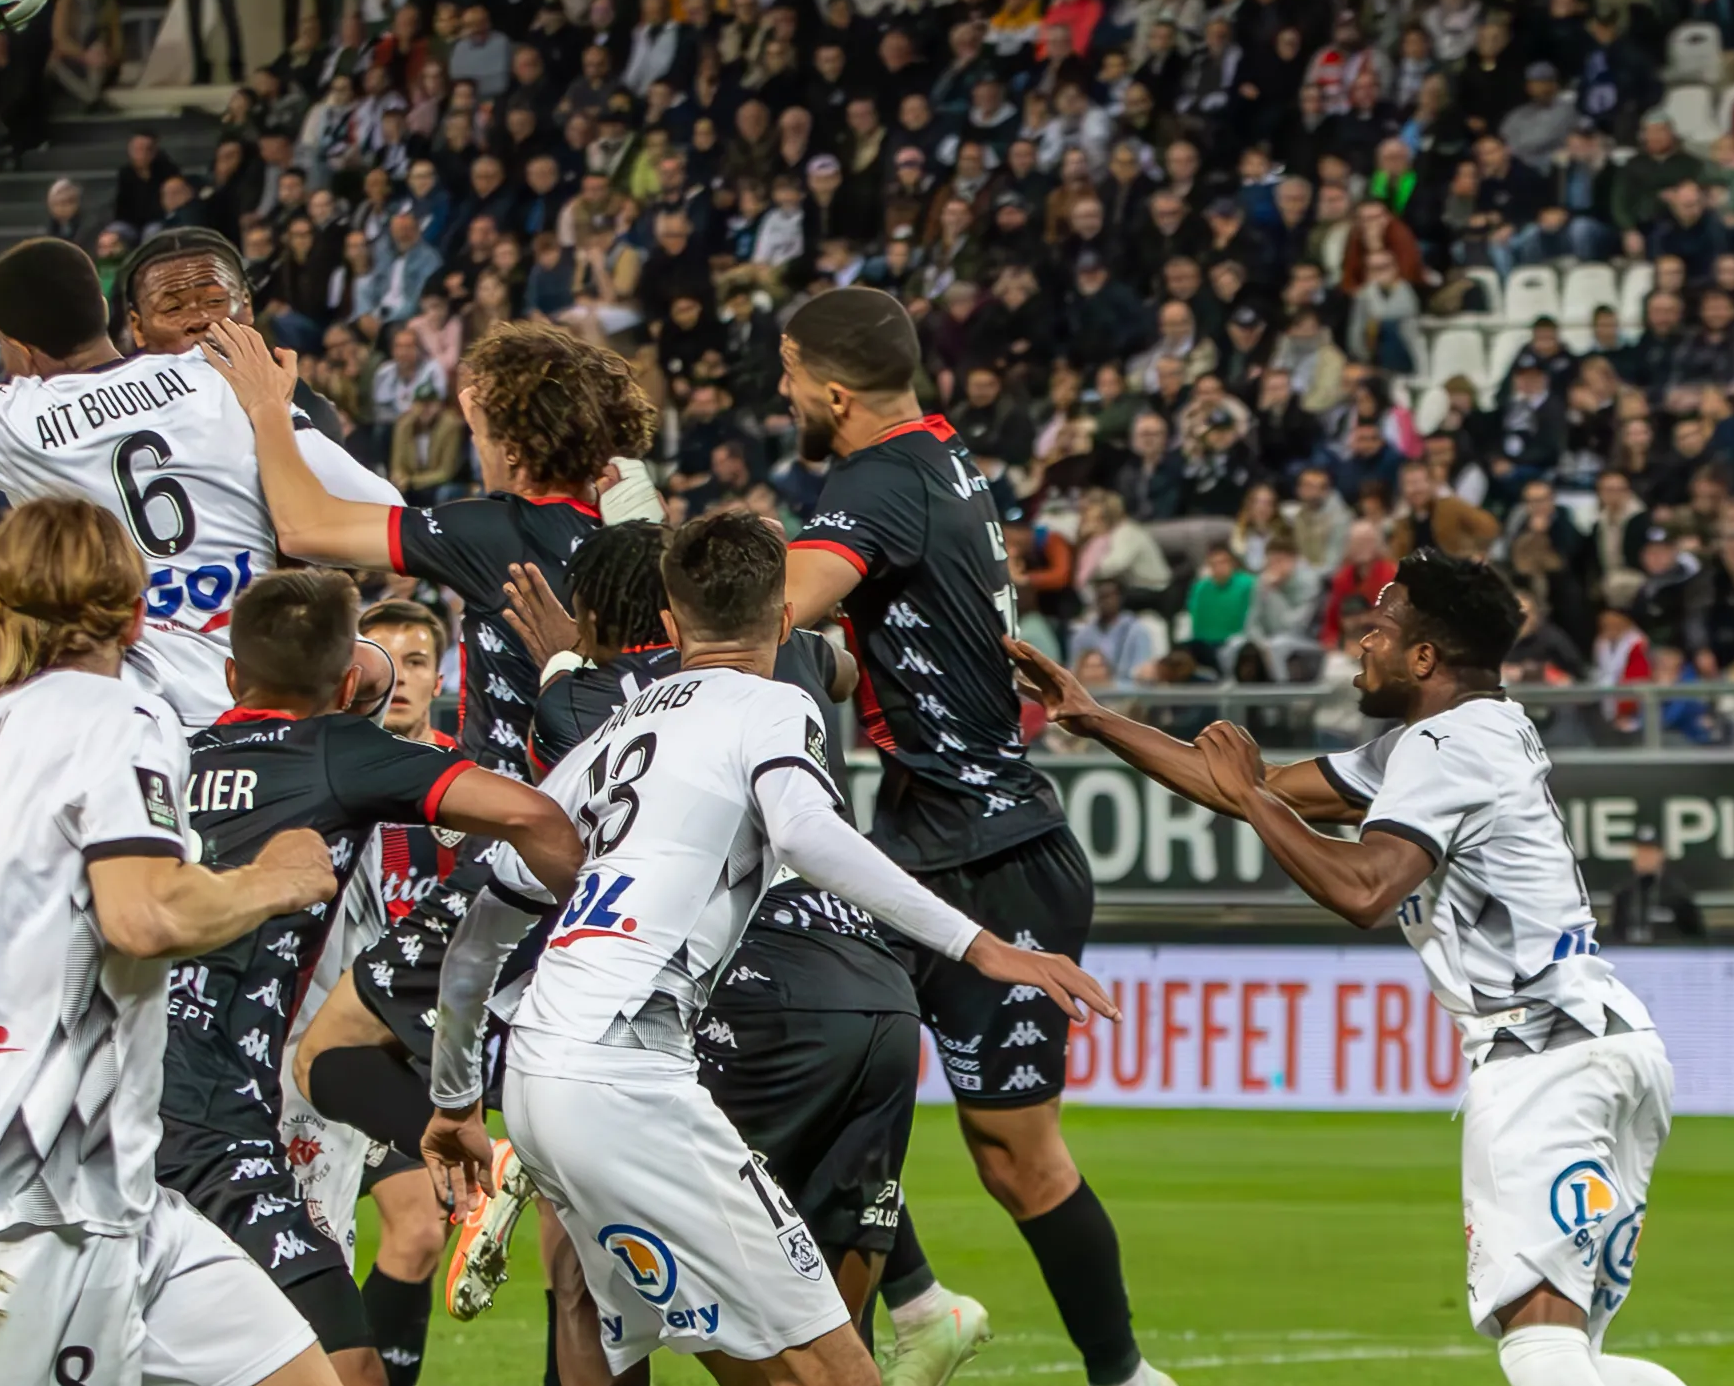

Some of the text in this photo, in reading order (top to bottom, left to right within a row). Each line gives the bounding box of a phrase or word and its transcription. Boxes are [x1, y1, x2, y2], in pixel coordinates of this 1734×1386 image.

[36, 368, 197, 450] AÏT BOUDLAL
[112, 429, 195, 559] 6
[576, 731, 658, 861] 13
[1066, 981, 1309, 1091] BUFFET
[1334, 983, 1462, 1095] FRO
